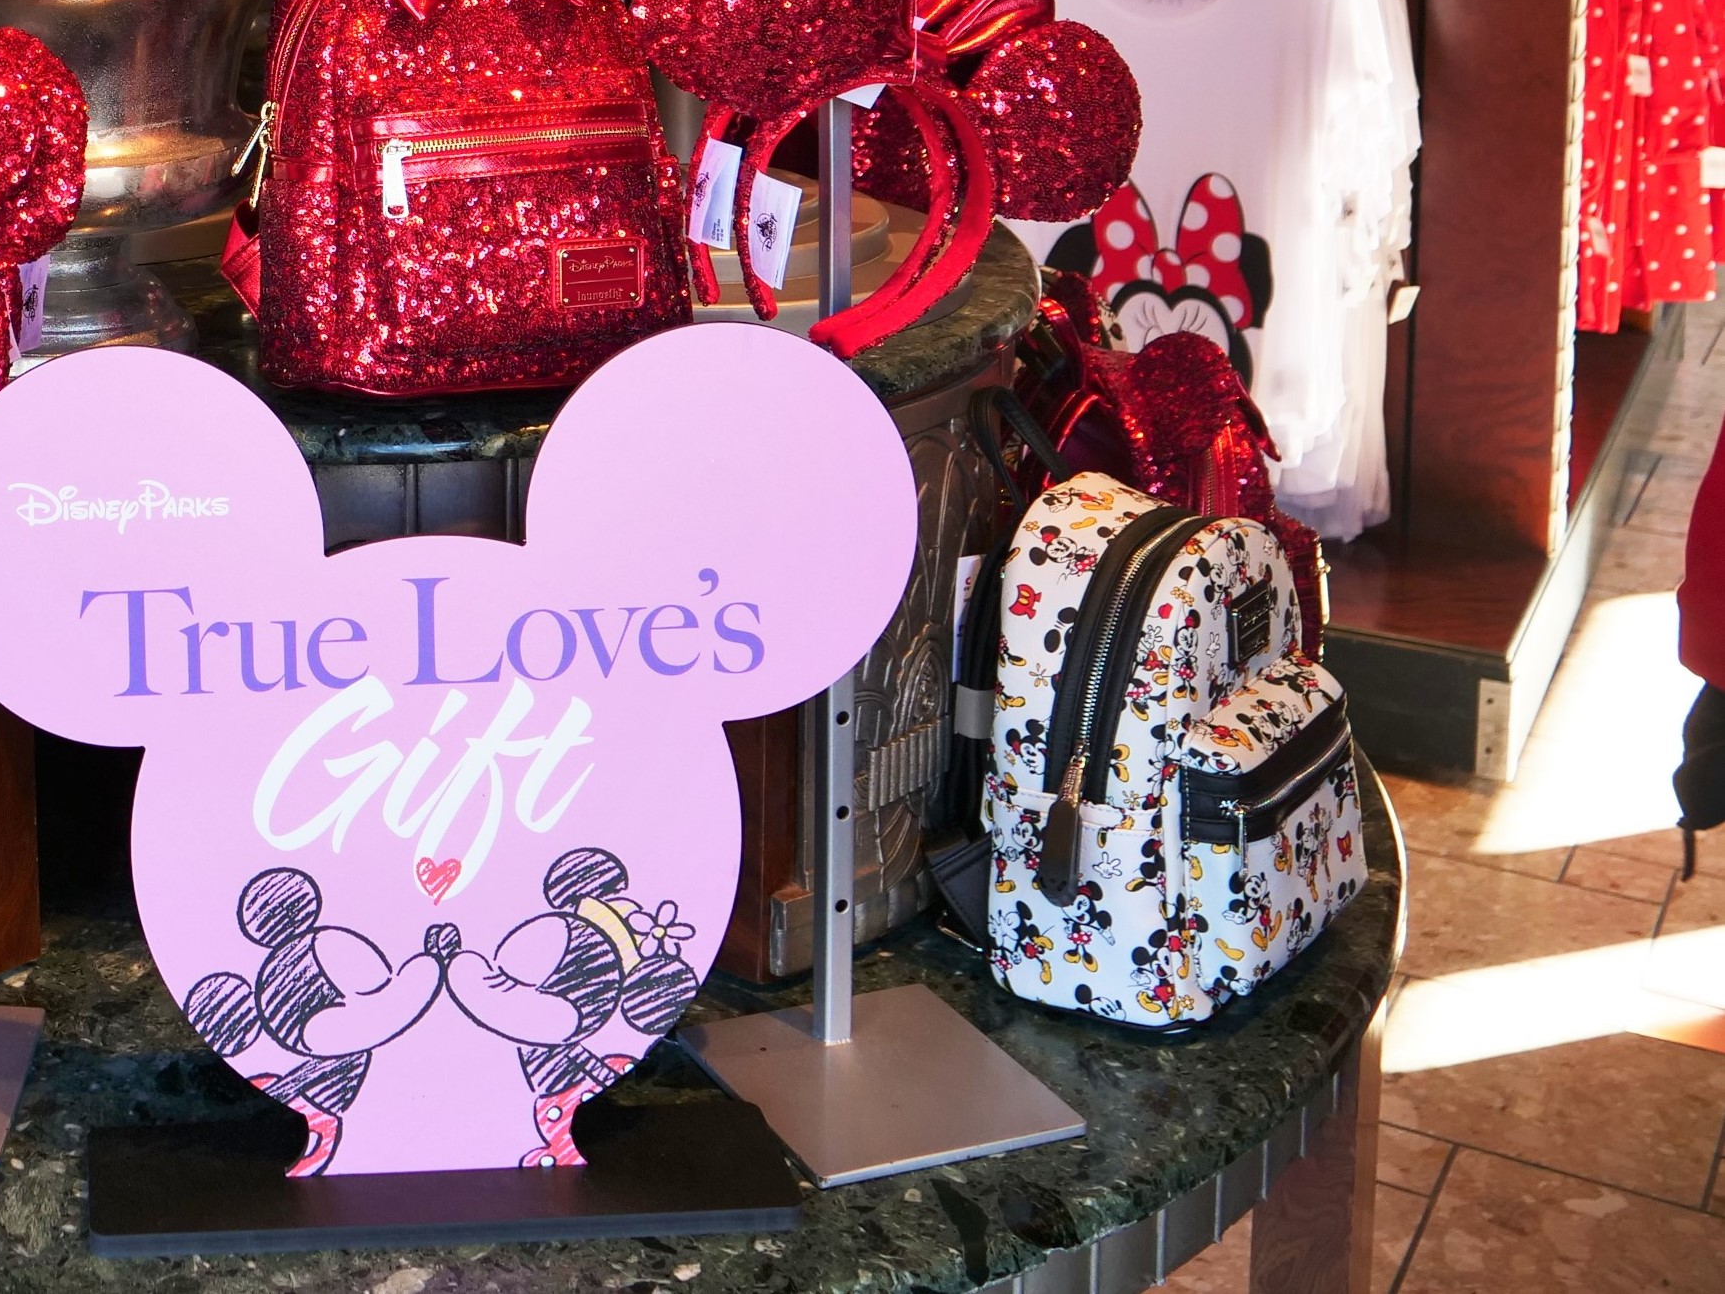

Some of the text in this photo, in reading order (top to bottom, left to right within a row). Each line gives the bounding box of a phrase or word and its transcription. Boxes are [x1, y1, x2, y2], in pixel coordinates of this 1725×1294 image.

[79, 567, 766, 698] True Love's
[252, 674, 595, 901] Gift
